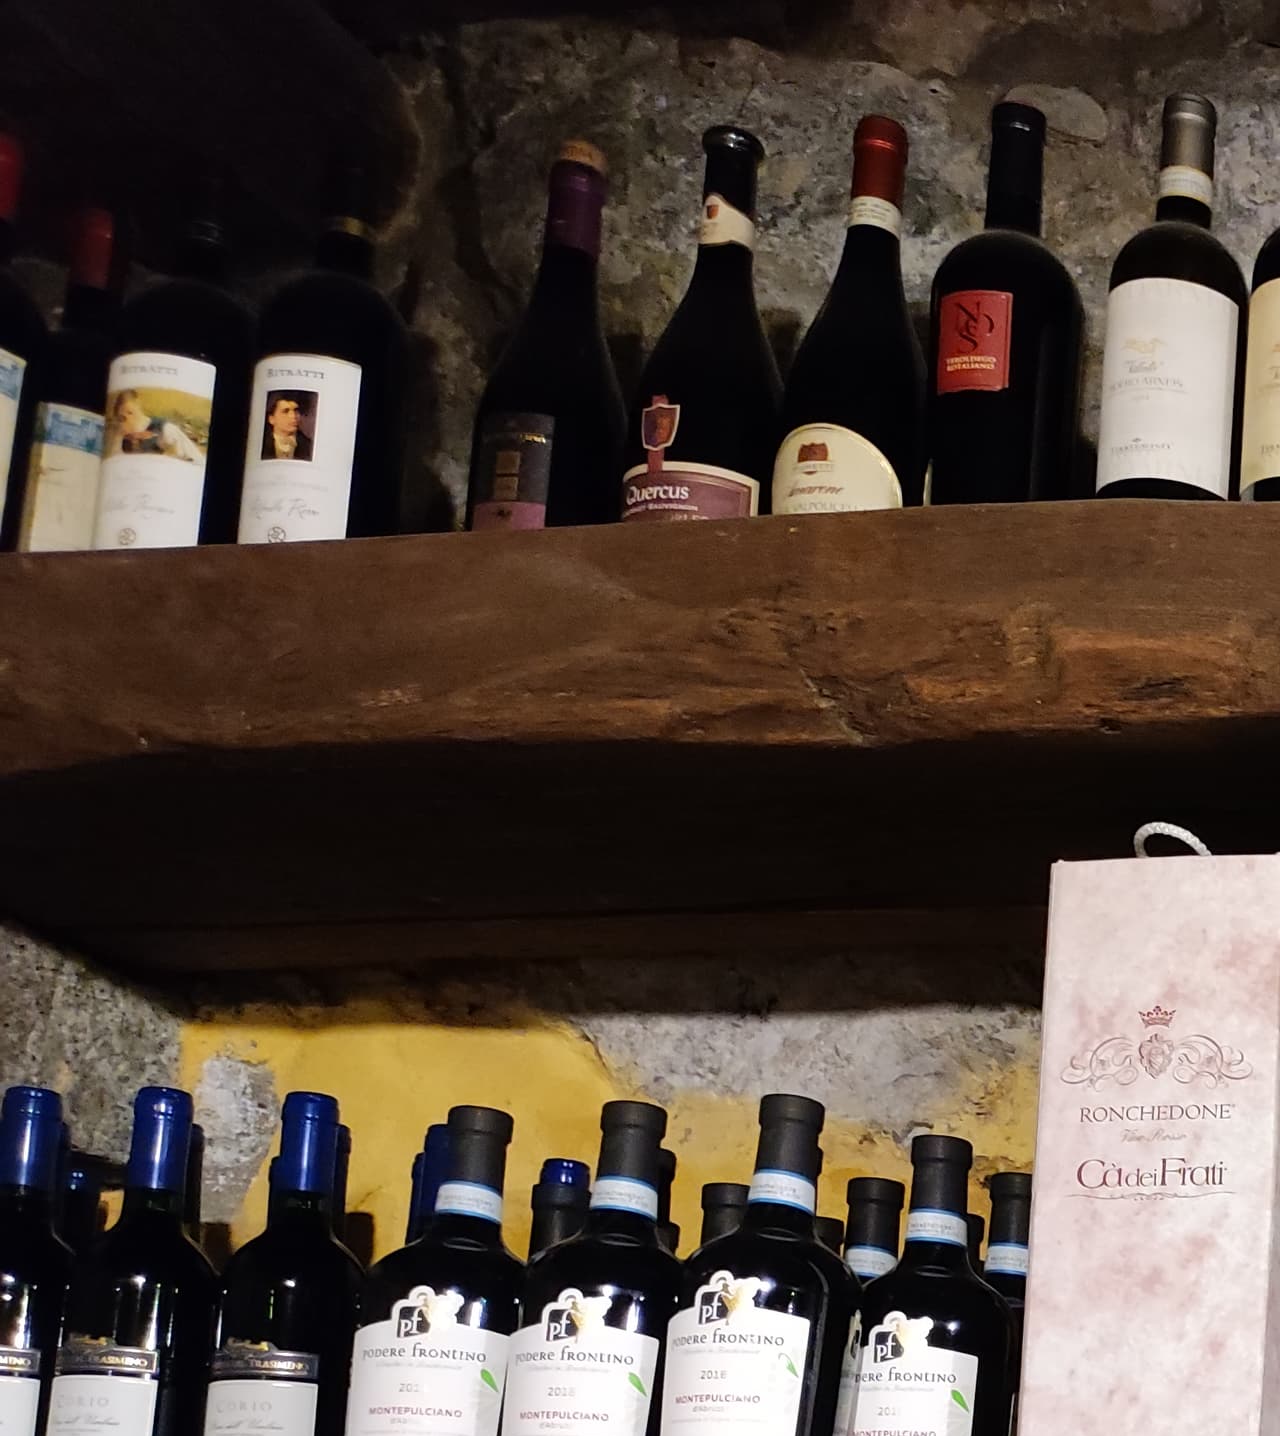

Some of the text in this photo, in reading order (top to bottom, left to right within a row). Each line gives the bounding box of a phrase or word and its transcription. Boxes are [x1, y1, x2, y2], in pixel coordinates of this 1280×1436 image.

[626, 484, 690, 506] Quercus
[1079, 1103, 1232, 1124] RONCHEDONE
[675, 1393, 761, 1405] MONTEPULCIANO
[368, 1406, 463, 1419] MONTEPULCIANO
[519, 1411, 610, 1422] MONTEPULCIANO
